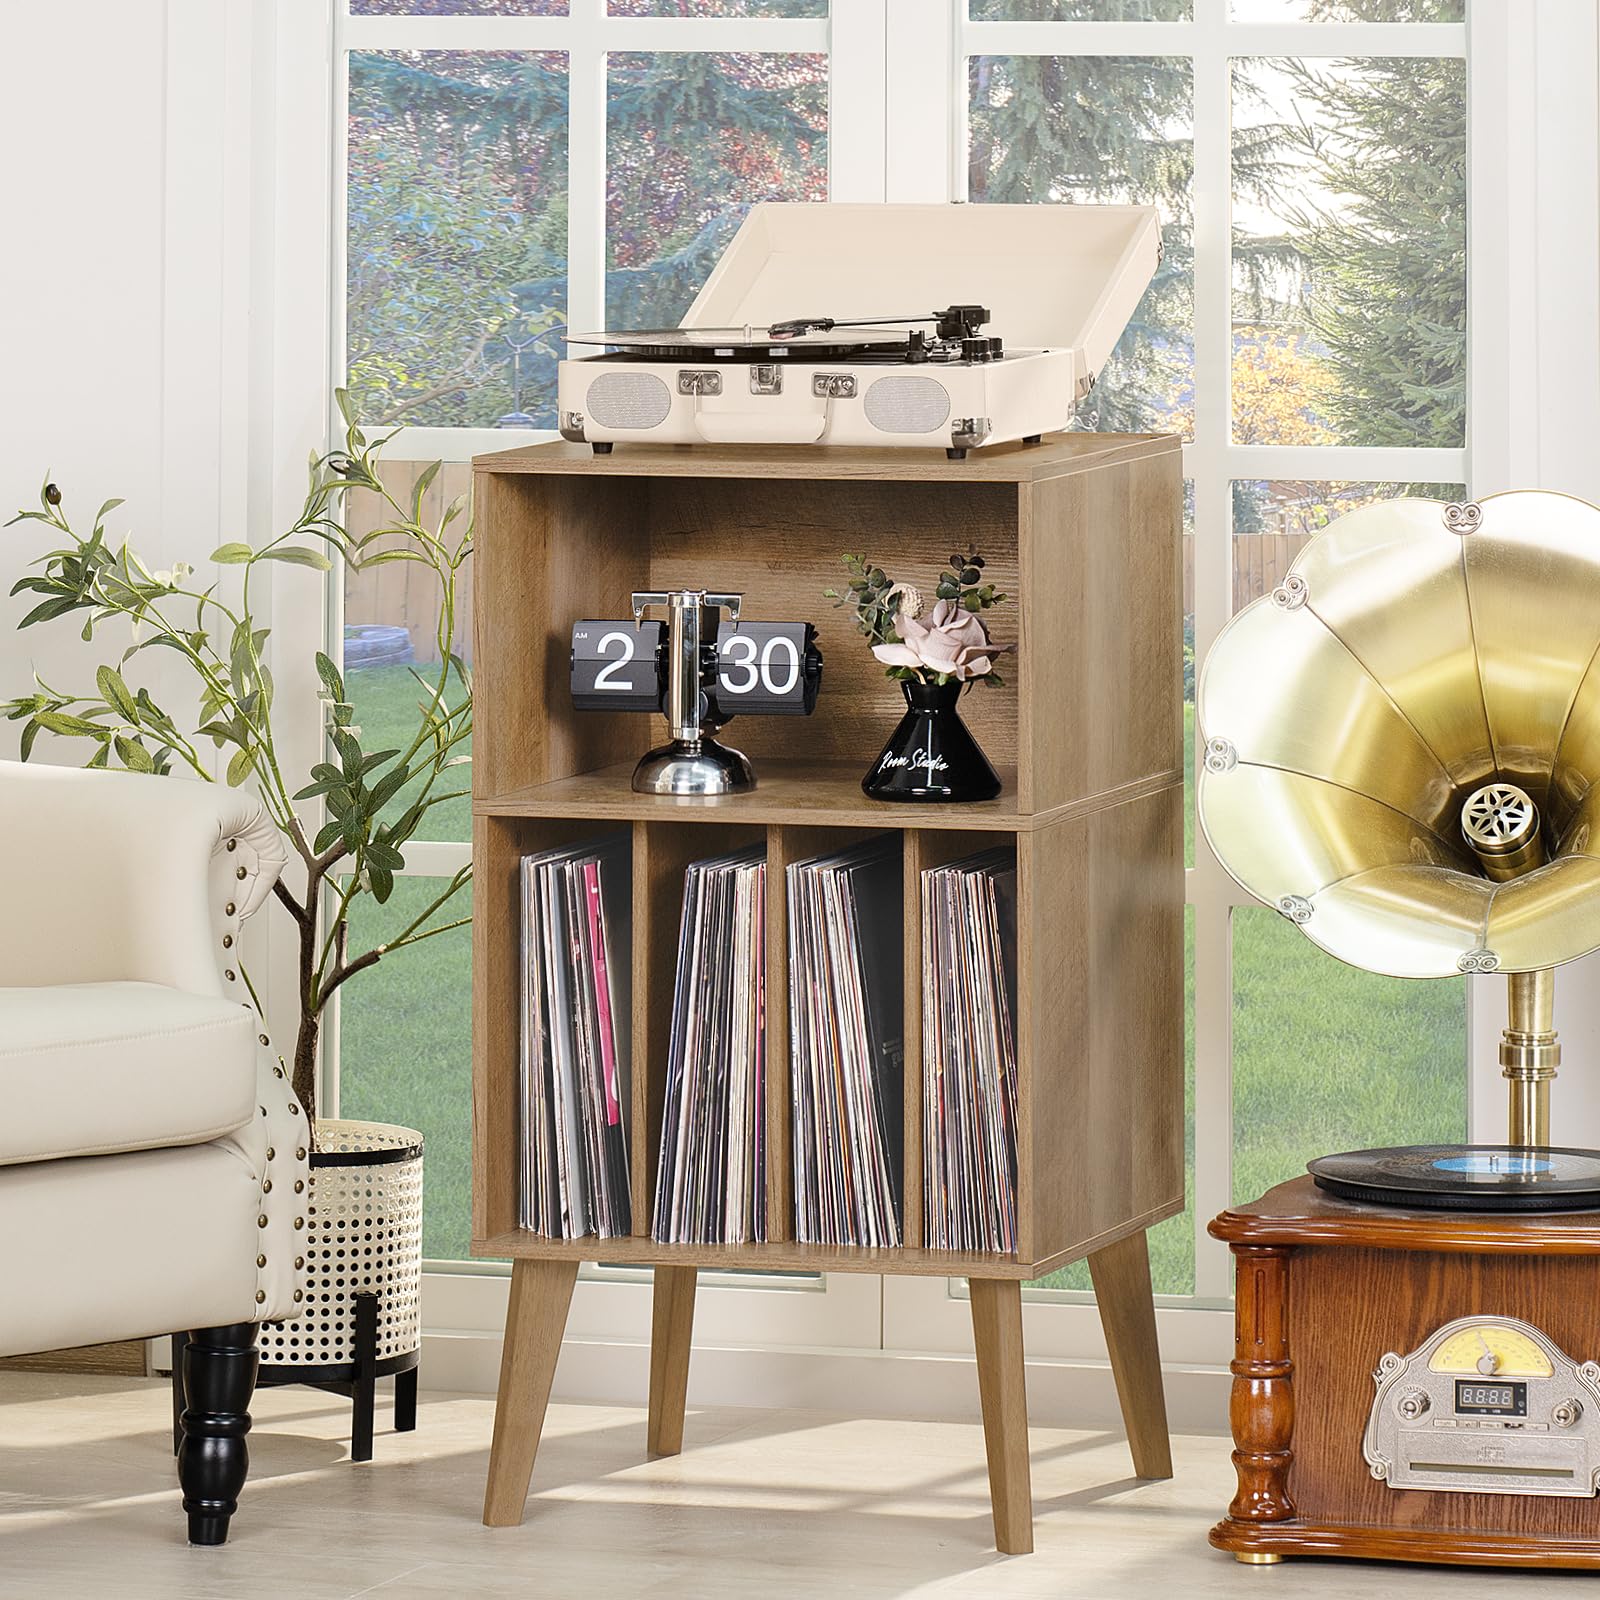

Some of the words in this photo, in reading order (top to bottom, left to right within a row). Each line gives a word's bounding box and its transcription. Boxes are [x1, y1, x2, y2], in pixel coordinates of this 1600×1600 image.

[594, 632, 635, 690] 2
[720, 635, 799, 695] 30
[878, 750, 909, 774] Room
[907, 748, 949, 771] Studio
